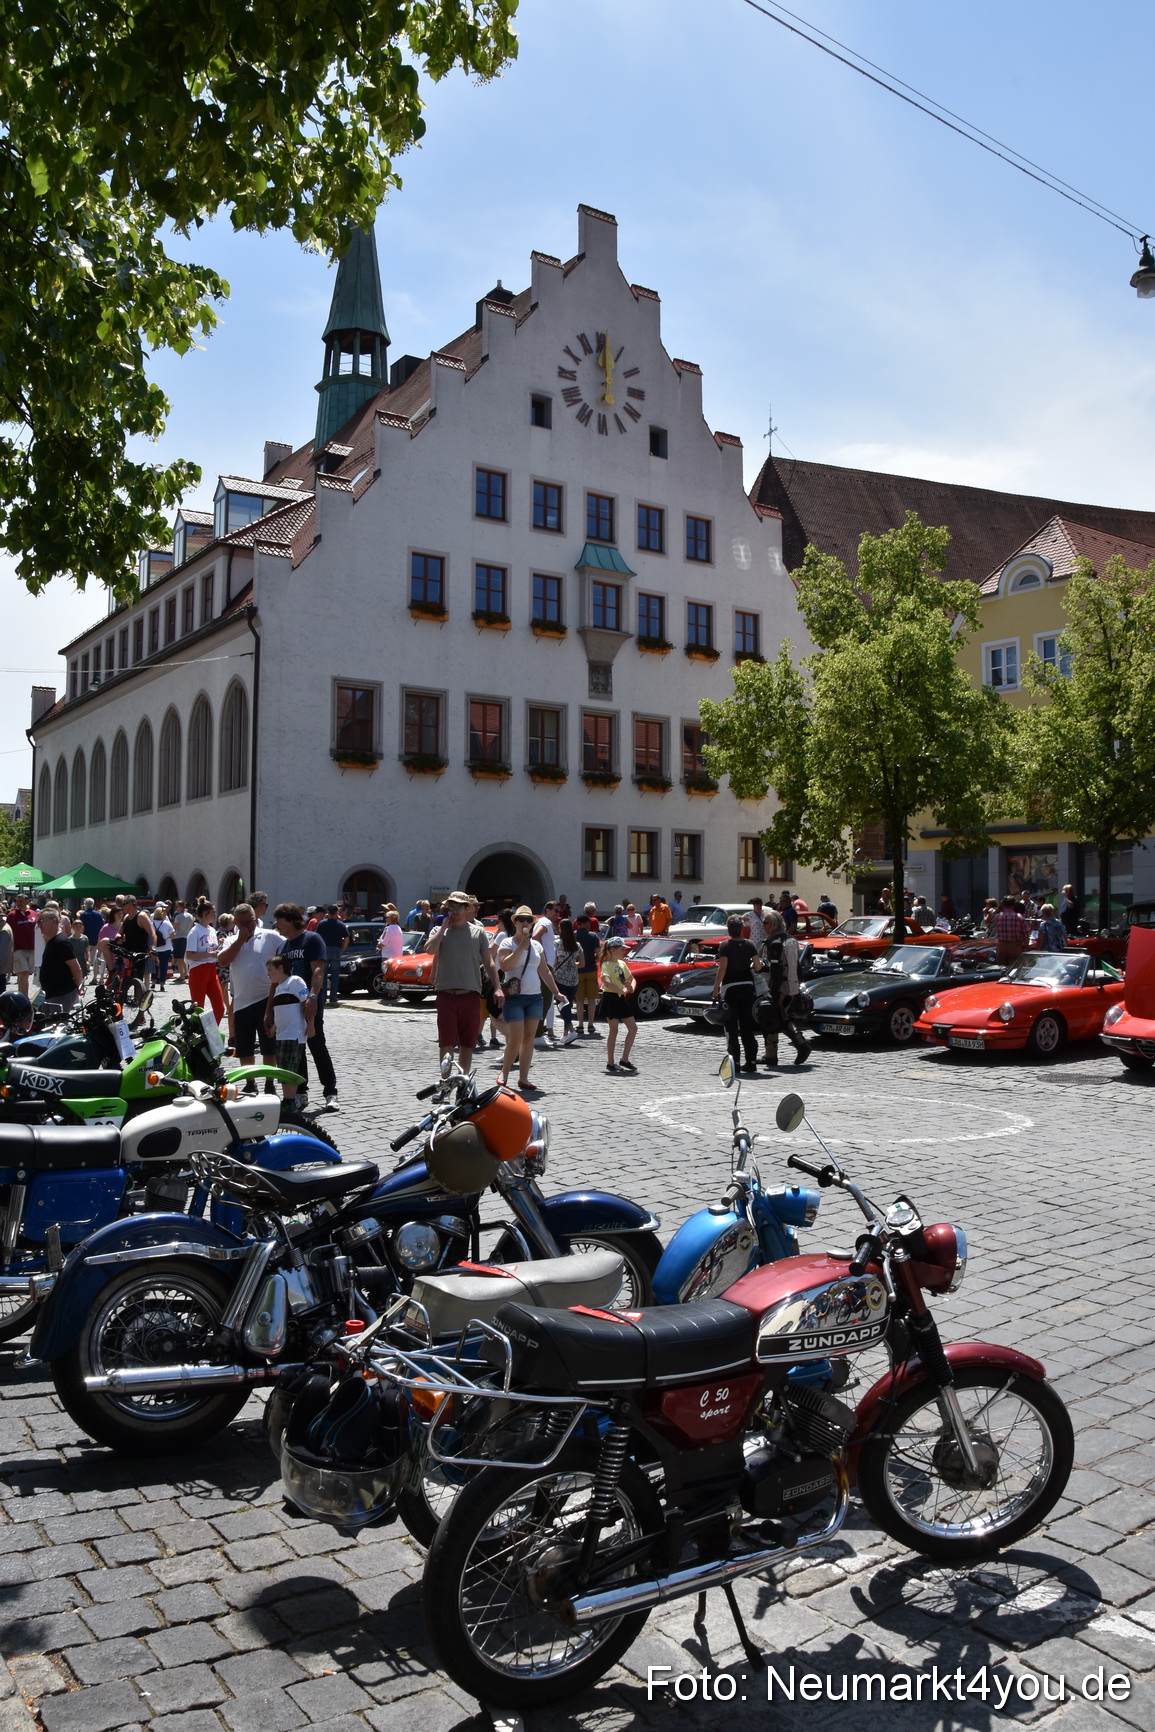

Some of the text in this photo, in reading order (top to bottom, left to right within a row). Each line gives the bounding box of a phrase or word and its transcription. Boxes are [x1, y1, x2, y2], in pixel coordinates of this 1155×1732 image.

[20, 1070, 65, 1095] KDX
[788, 1325, 880, 1351] ZÜNDAPP
[700, 1388, 729, 1407] C 50
[700, 1405, 730, 1420] sport
